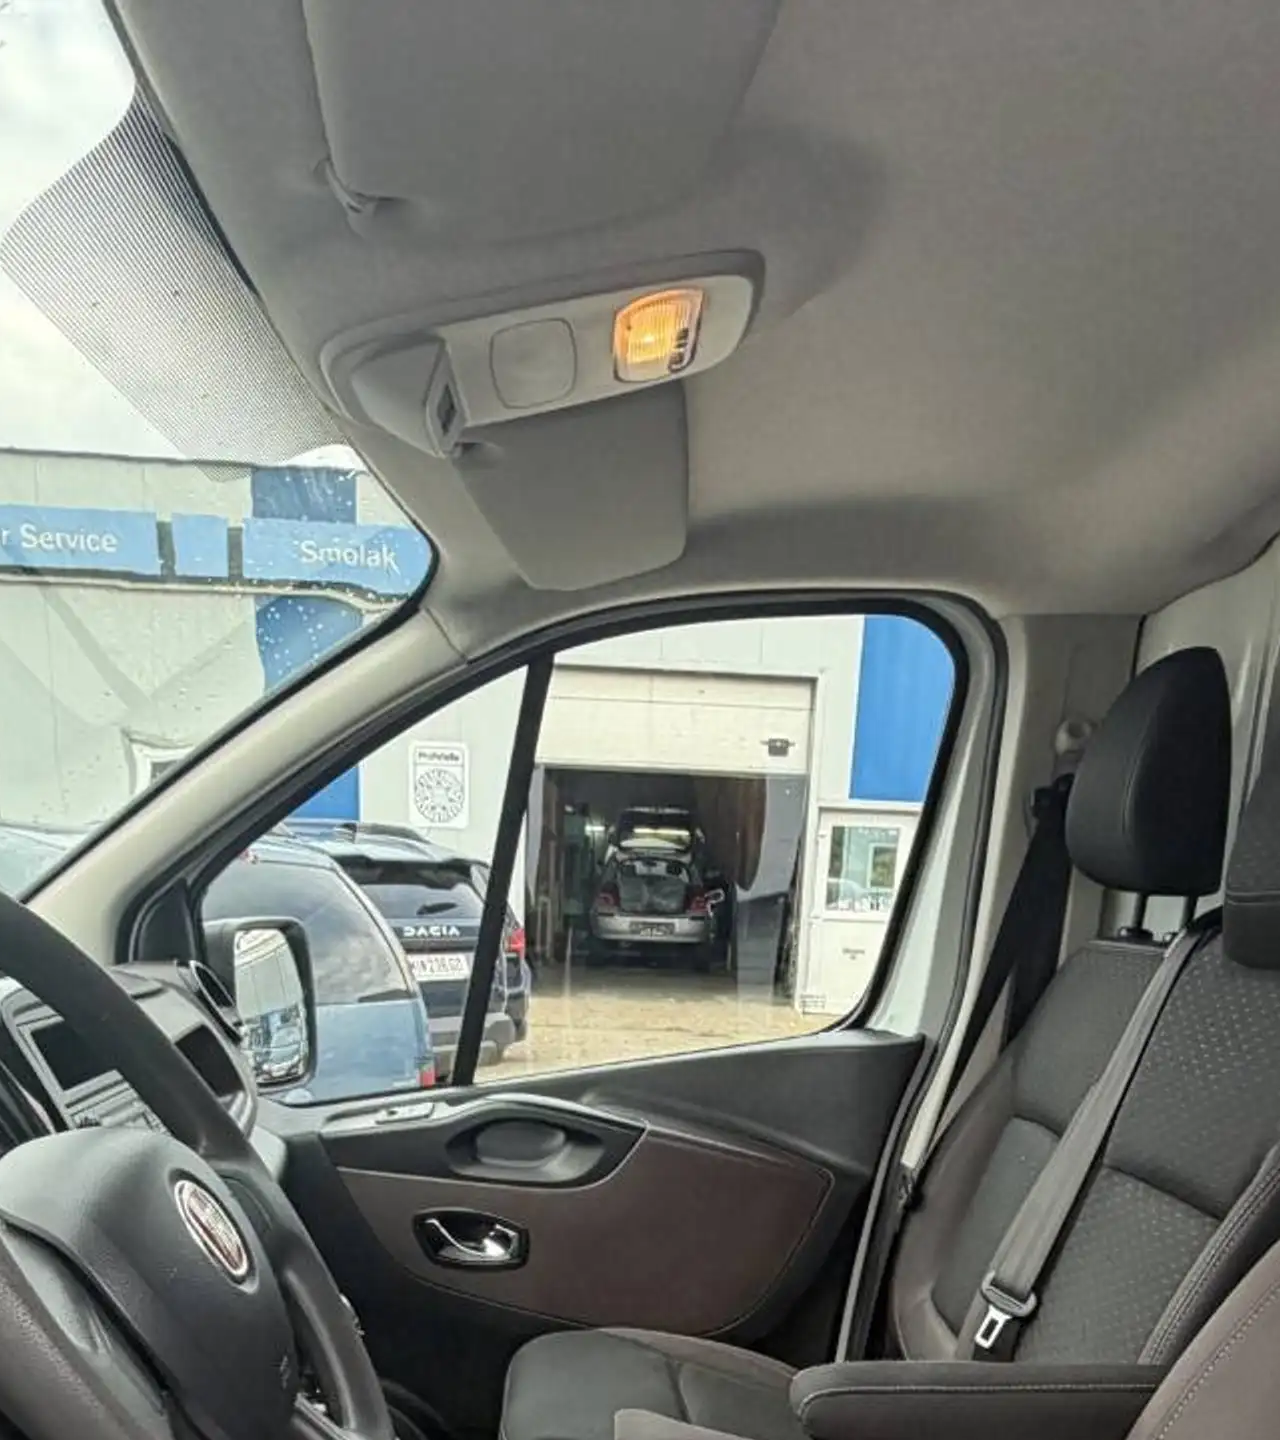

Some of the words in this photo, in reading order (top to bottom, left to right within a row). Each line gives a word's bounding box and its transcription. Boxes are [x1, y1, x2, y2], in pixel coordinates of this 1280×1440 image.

[20, 523, 118, 553] Service
[299, 539, 401, 576] Smolak
[402, 925, 461, 938] DACIA
